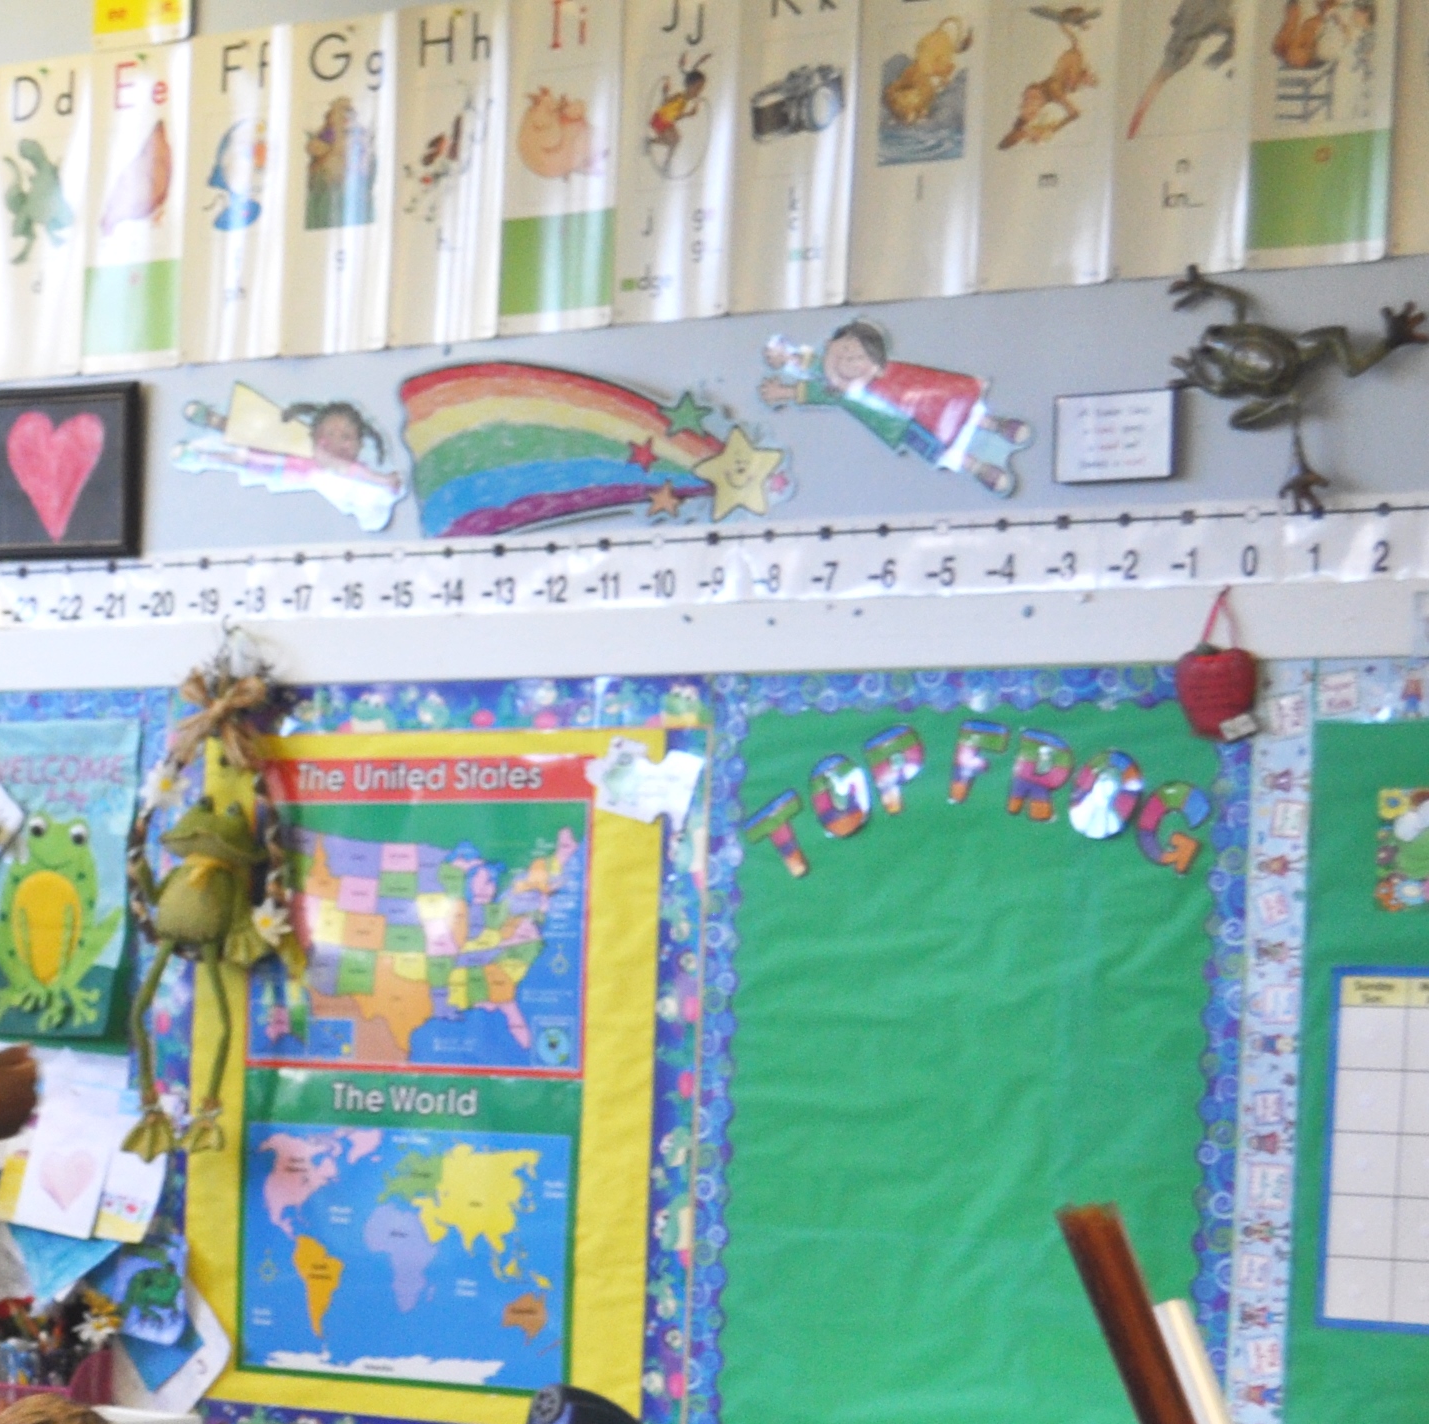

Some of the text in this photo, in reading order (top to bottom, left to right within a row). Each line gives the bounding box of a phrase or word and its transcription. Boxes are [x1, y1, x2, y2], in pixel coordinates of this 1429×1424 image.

[49, 595, 82, 620] -22
[95, 592, 125, 618] -21
[140, 591, 174, 616] -20
[283, 585, 312, 611] -17
[332, 582, 362, 609] -16
[381, 581, 413, 608] -15
[430, 579, 463, 605] -14
[481, 577, 515, 604] -13
[534, 575, 567, 603] -12
[585, 572, 619, 599] -11
[640, 569, 676, 598] -10
[753, 563, 780, 593] -8
[812, 562, 838, 590] -7
[868, 558, 896, 588] -6
[926, 556, 956, 586] -5
[986, 553, 1015, 584] -4
[1047, 552, 1076, 579] -3
[1109, 550, 1138, 579] -2
[1171, 548, 1196, 578] -1
[1243, 545, 1258, 576] 0
[1309, 544, 1320, 571] 1
[1373, 541, 1390, 572] 2
[297, 759, 543, 791] The United States
[744, 718, 1211, 878] TOP FROG
[332, 1083, 479, 1117] The World
